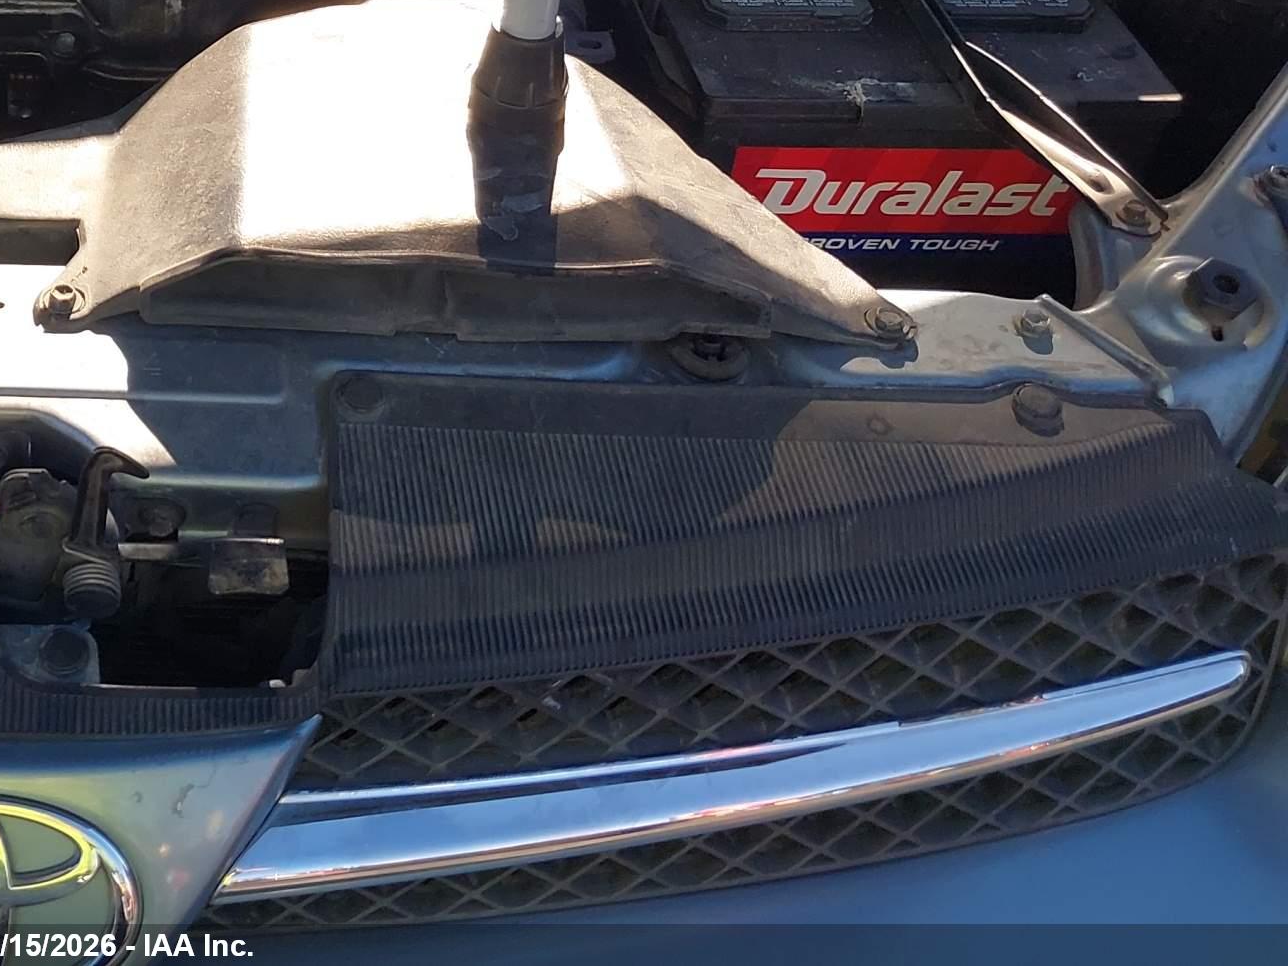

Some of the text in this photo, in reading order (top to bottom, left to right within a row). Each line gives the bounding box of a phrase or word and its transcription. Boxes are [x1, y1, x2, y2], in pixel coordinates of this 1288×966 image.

[755, 168, 1070, 217] Duralast
[802, 237, 1001, 252] ROVEN TOUGH
